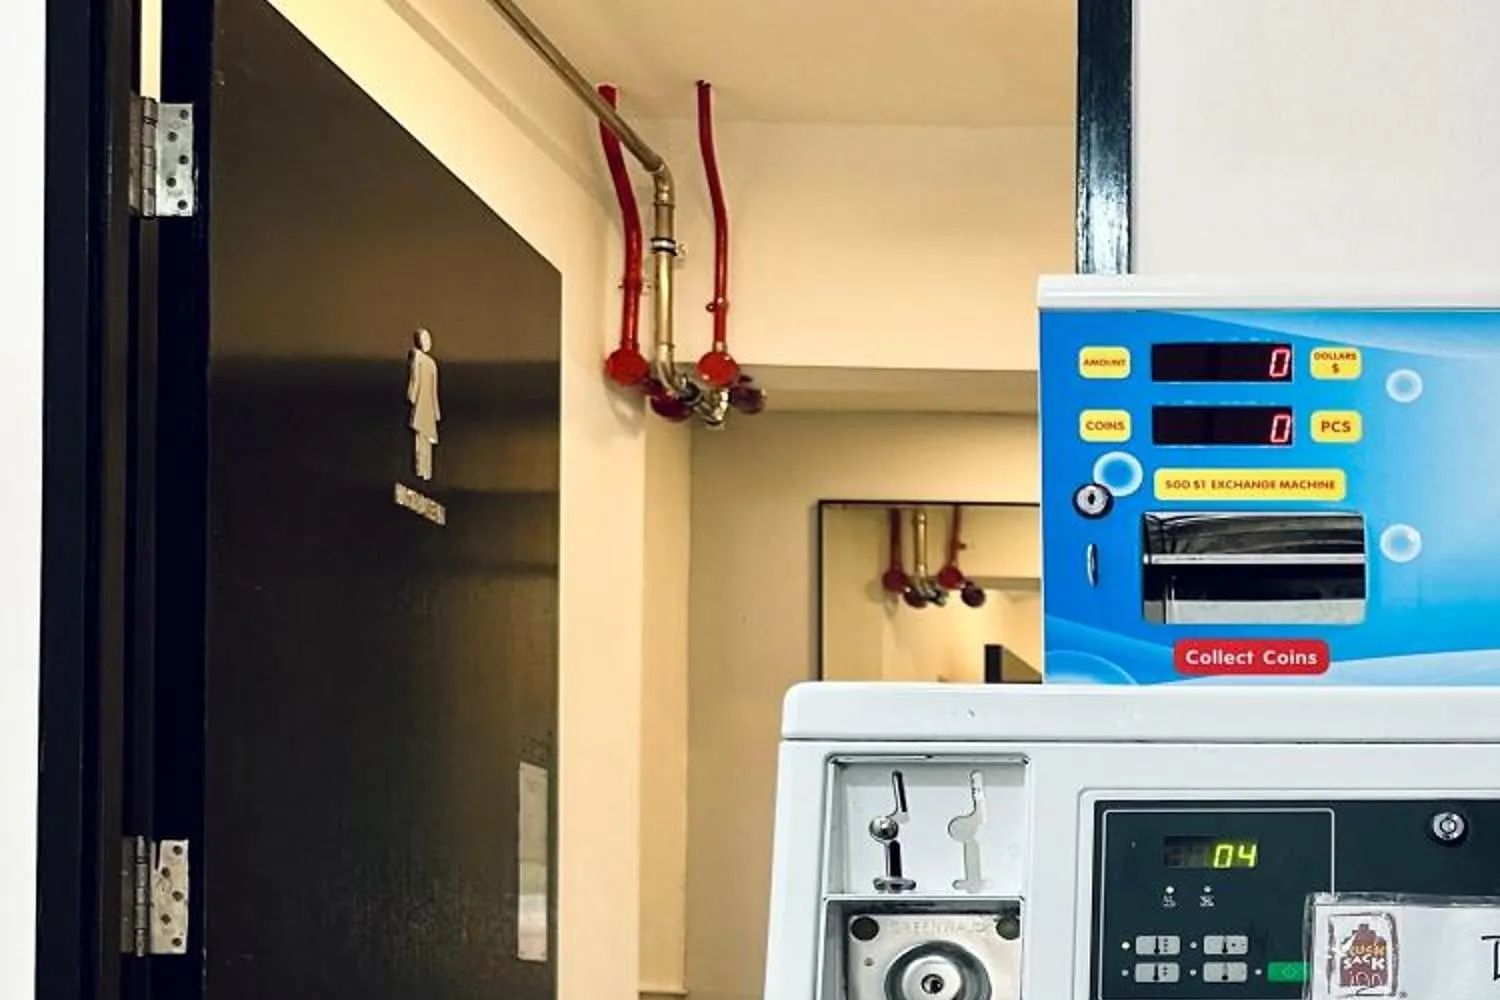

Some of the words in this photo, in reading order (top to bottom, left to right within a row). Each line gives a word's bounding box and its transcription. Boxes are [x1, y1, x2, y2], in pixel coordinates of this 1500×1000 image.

[1083, 358, 1126, 367] AMOUNT
[1313, 351, 1358, 361] DOLLARS
[1268, 348, 1291, 378] 0
[1085, 420, 1126, 432] COINS
[1269, 413, 1291, 443] 0
[1320, 420, 1352, 433] PCS
[1210, 479, 1277, 490] EXCHANGE
[1279, 479, 1336, 490] MACHINE
[1185, 648, 1255, 666] Collect
[1263, 648, 1318, 666] Coins
[1212, 843, 1258, 869] 04
